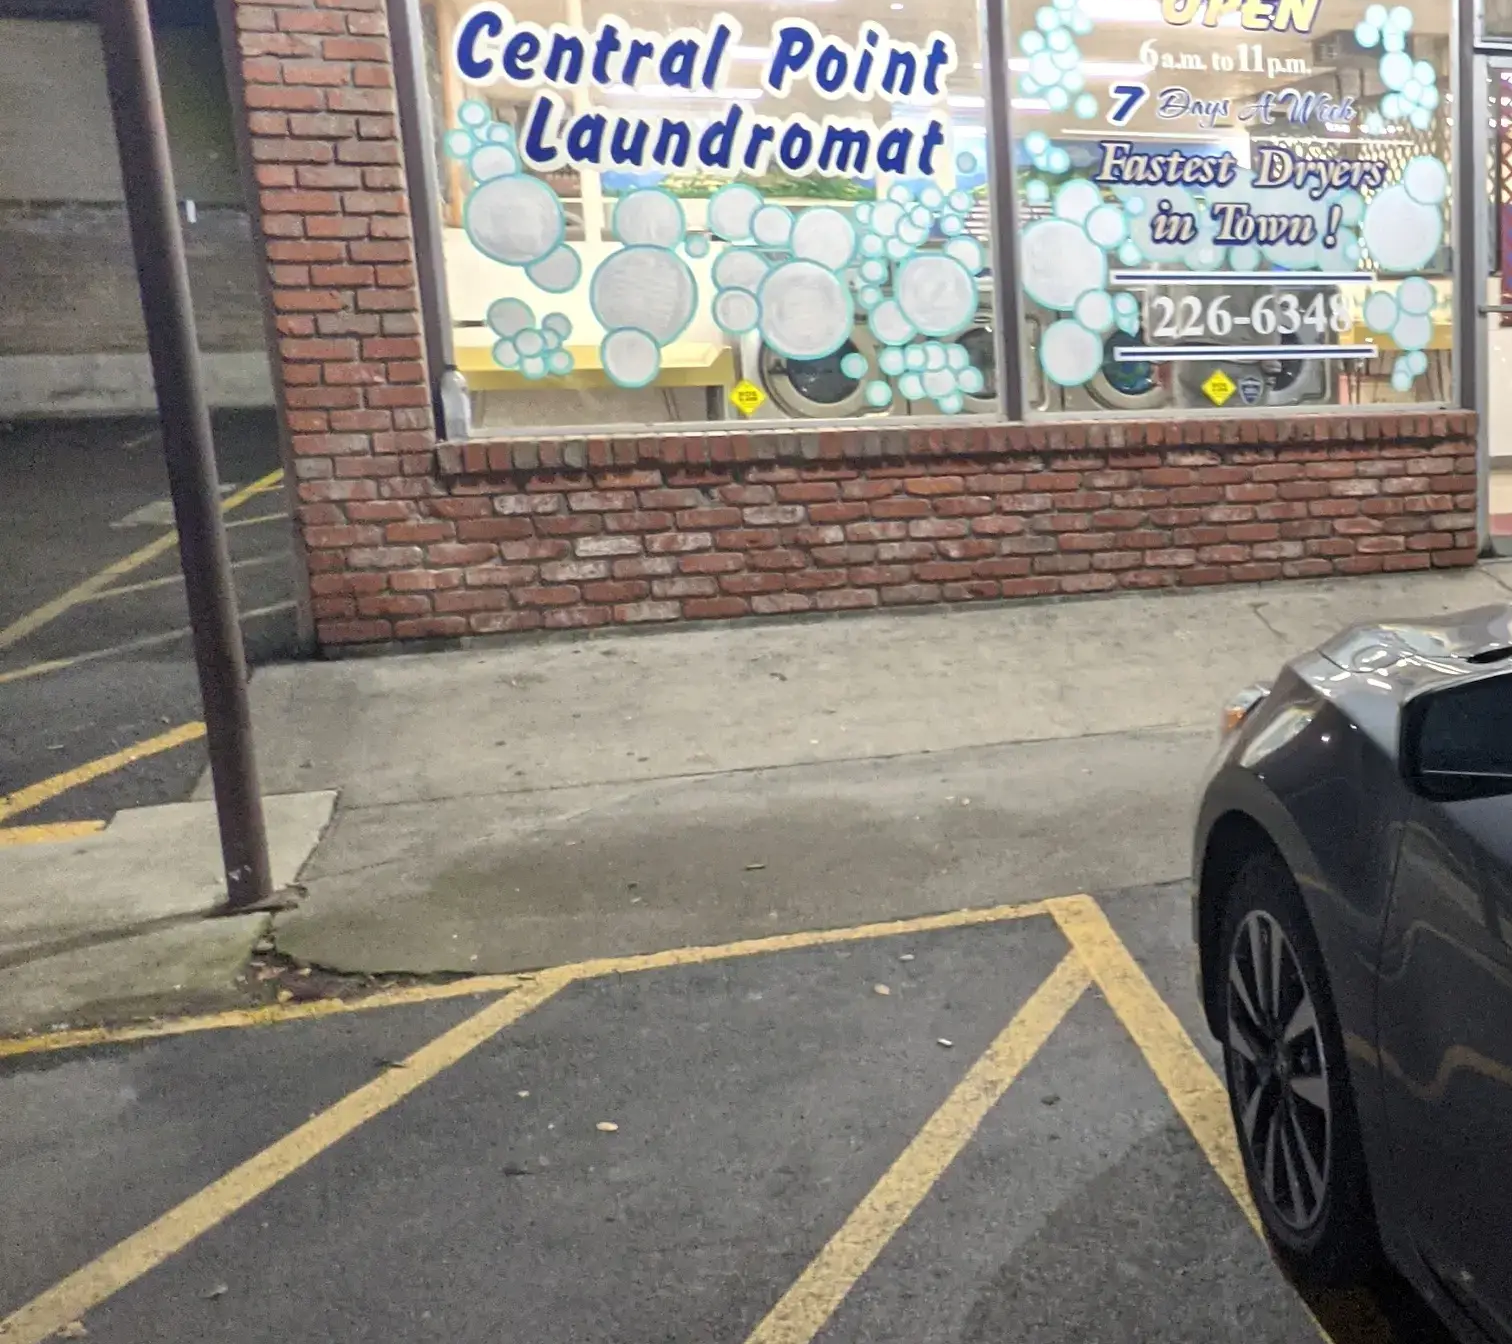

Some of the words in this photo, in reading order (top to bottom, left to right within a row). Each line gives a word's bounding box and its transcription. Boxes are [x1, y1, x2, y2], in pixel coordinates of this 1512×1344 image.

[454, 6, 735, 94] Central
[767, 24, 952, 97] Point
[1139, 38, 1158, 72] 6
[1160, 50, 1208, 70] a.m.
[1212, 50, 1234, 71] to
[1236, 42, 1263, 72] 11
[1266, 55, 1313, 78] p.m.
[1109, 83, 1149, 126] 7
[1157, 86, 1231, 128] Days
[1238, 90, 1277, 125] A
[1277, 88, 1357, 125] Week
[523, 96, 945, 176] Laundromat
[1094, 141, 1239, 187] Fastest
[1251, 146, 1388, 201] Dryers
[1151, 199, 1198, 244] in
[1152, 292, 1353, 340] 226-6348
